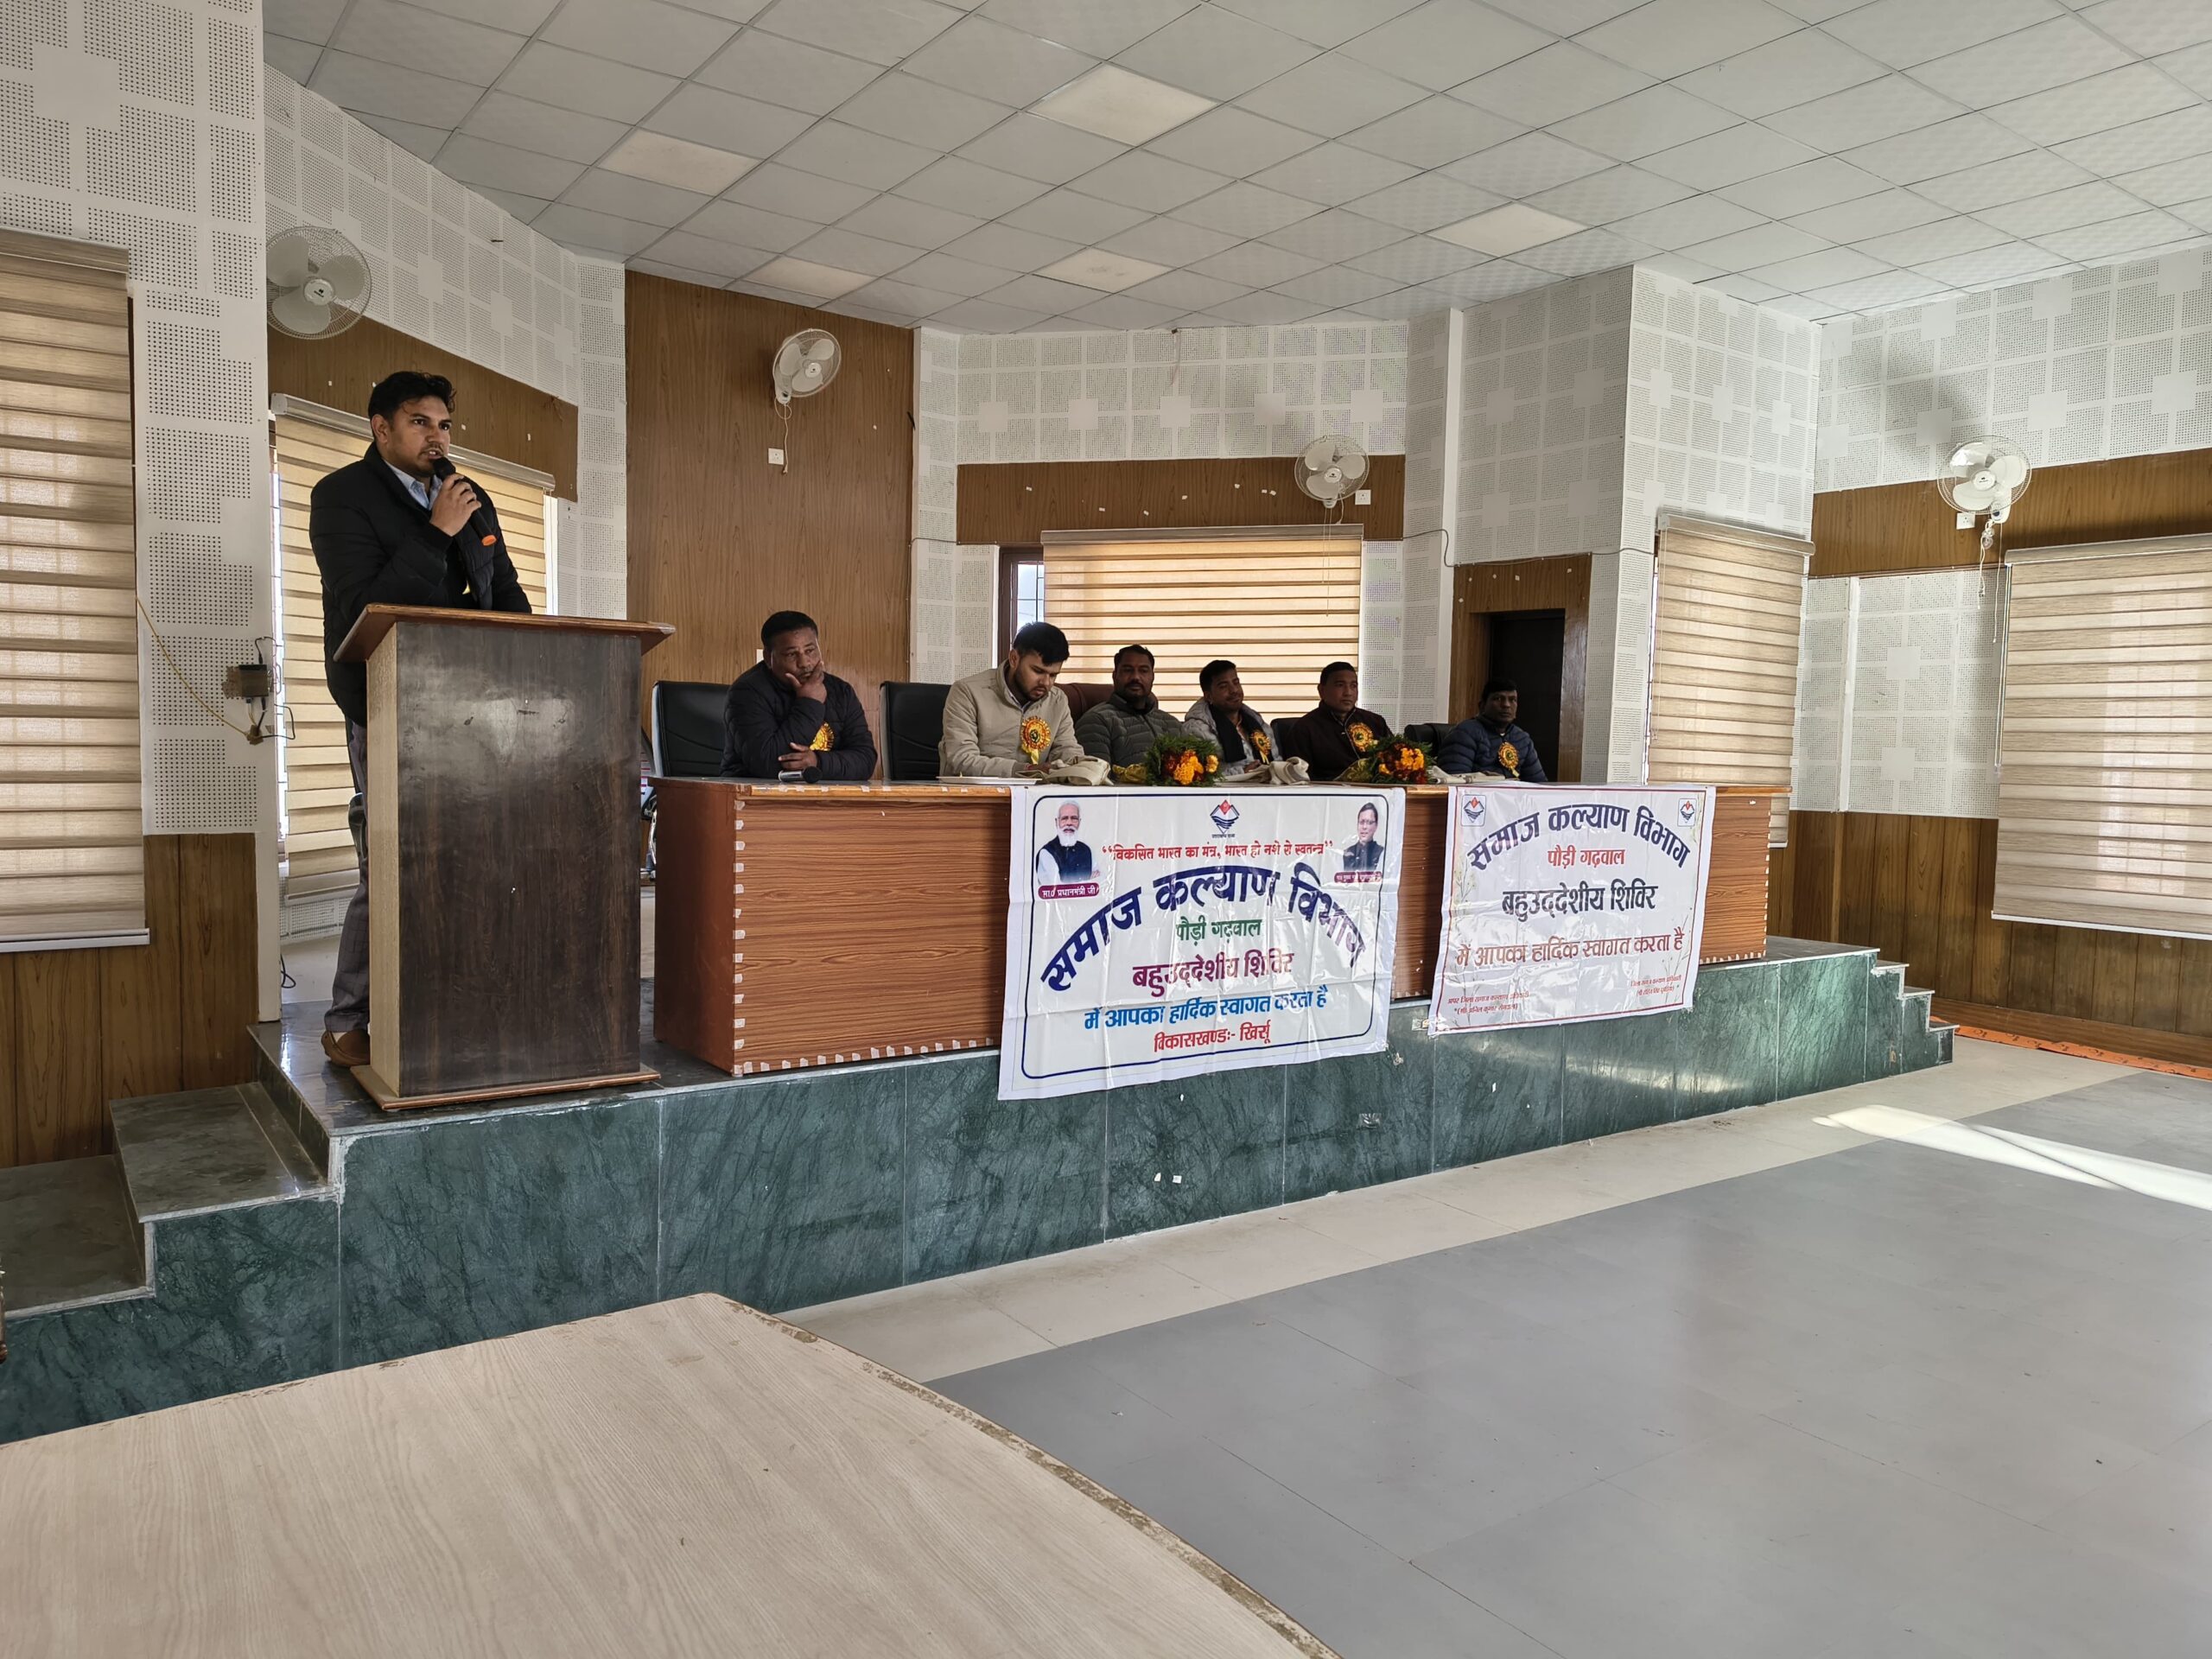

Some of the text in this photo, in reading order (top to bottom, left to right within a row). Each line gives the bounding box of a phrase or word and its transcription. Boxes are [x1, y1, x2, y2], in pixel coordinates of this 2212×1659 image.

[1158, 847, 1182, 859] भारत
[1185, 846, 1199, 858] का
[1225, 844, 1249, 857] भारत
[1250, 840, 1262, 858] हो
[1264, 840, 1281, 855] नशे
[1467, 804, 1691, 870] समाज कल्याण विभाग
[1548, 844, 1625, 869] पौड़ी गढ़वाल
[1057, 885, 1085, 897] प्रधानमंत्री
[1087, 885, 1096, 894] जी
[1610, 877, 1658, 911] शिविर
[1040, 862, 1365, 991] समाज कल्याण विभाग
[1176, 915, 1262, 946] पौड़ी गढ़वाल
[1456, 925, 1685, 966] में आपका हार्दिक स्वागत करता है
[1244, 948, 1294, 978] शिविर
[1084, 984, 1328, 1029] में आपका हार्दिक स्वागत करता है
[1240, 1020, 1271, 1044] खिर्सू
